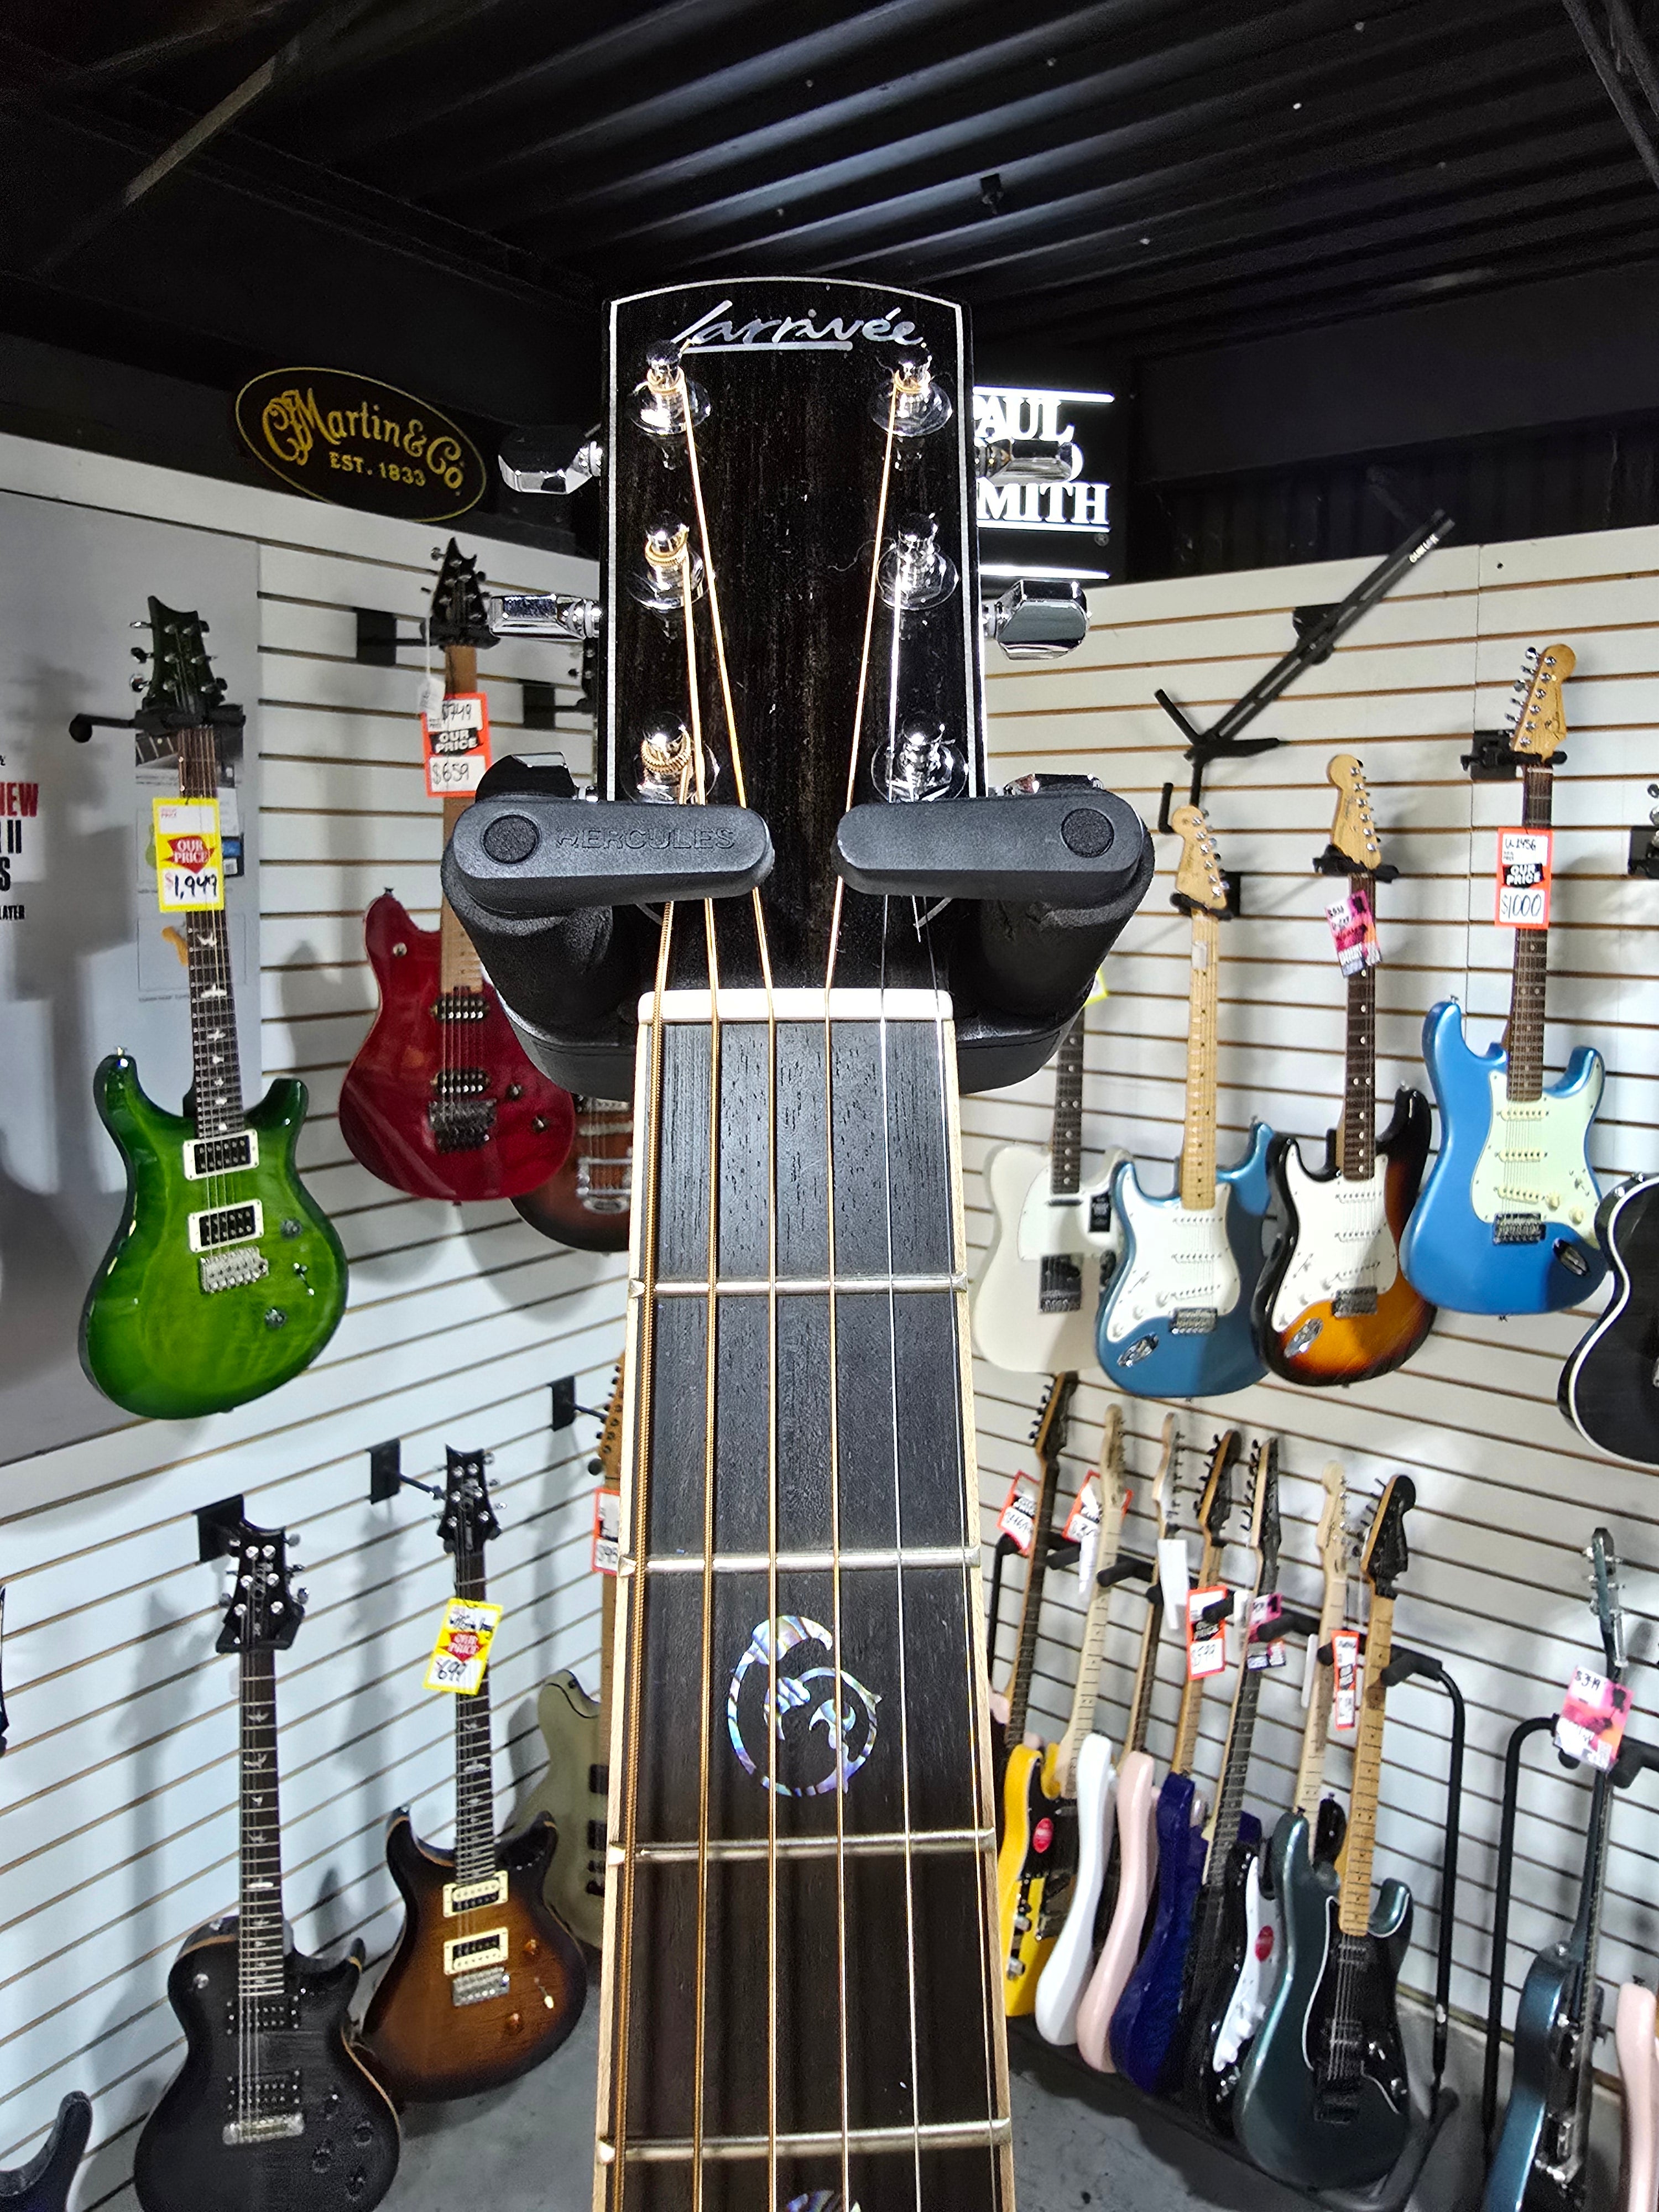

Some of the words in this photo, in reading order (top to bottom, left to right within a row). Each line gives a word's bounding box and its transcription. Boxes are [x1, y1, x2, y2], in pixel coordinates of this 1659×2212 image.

[329, 451, 373, 476] EST.
[379, 462, 426, 487] 1833
[975, 477, 1110, 525] MITH
[439, 730, 469, 743] OUR
[435, 738, 478, 754] PRICE
[177, 839, 204, 852] OUR
[556, 828, 736, 849] HERCULES
[174, 851, 207, 863] PRICE
